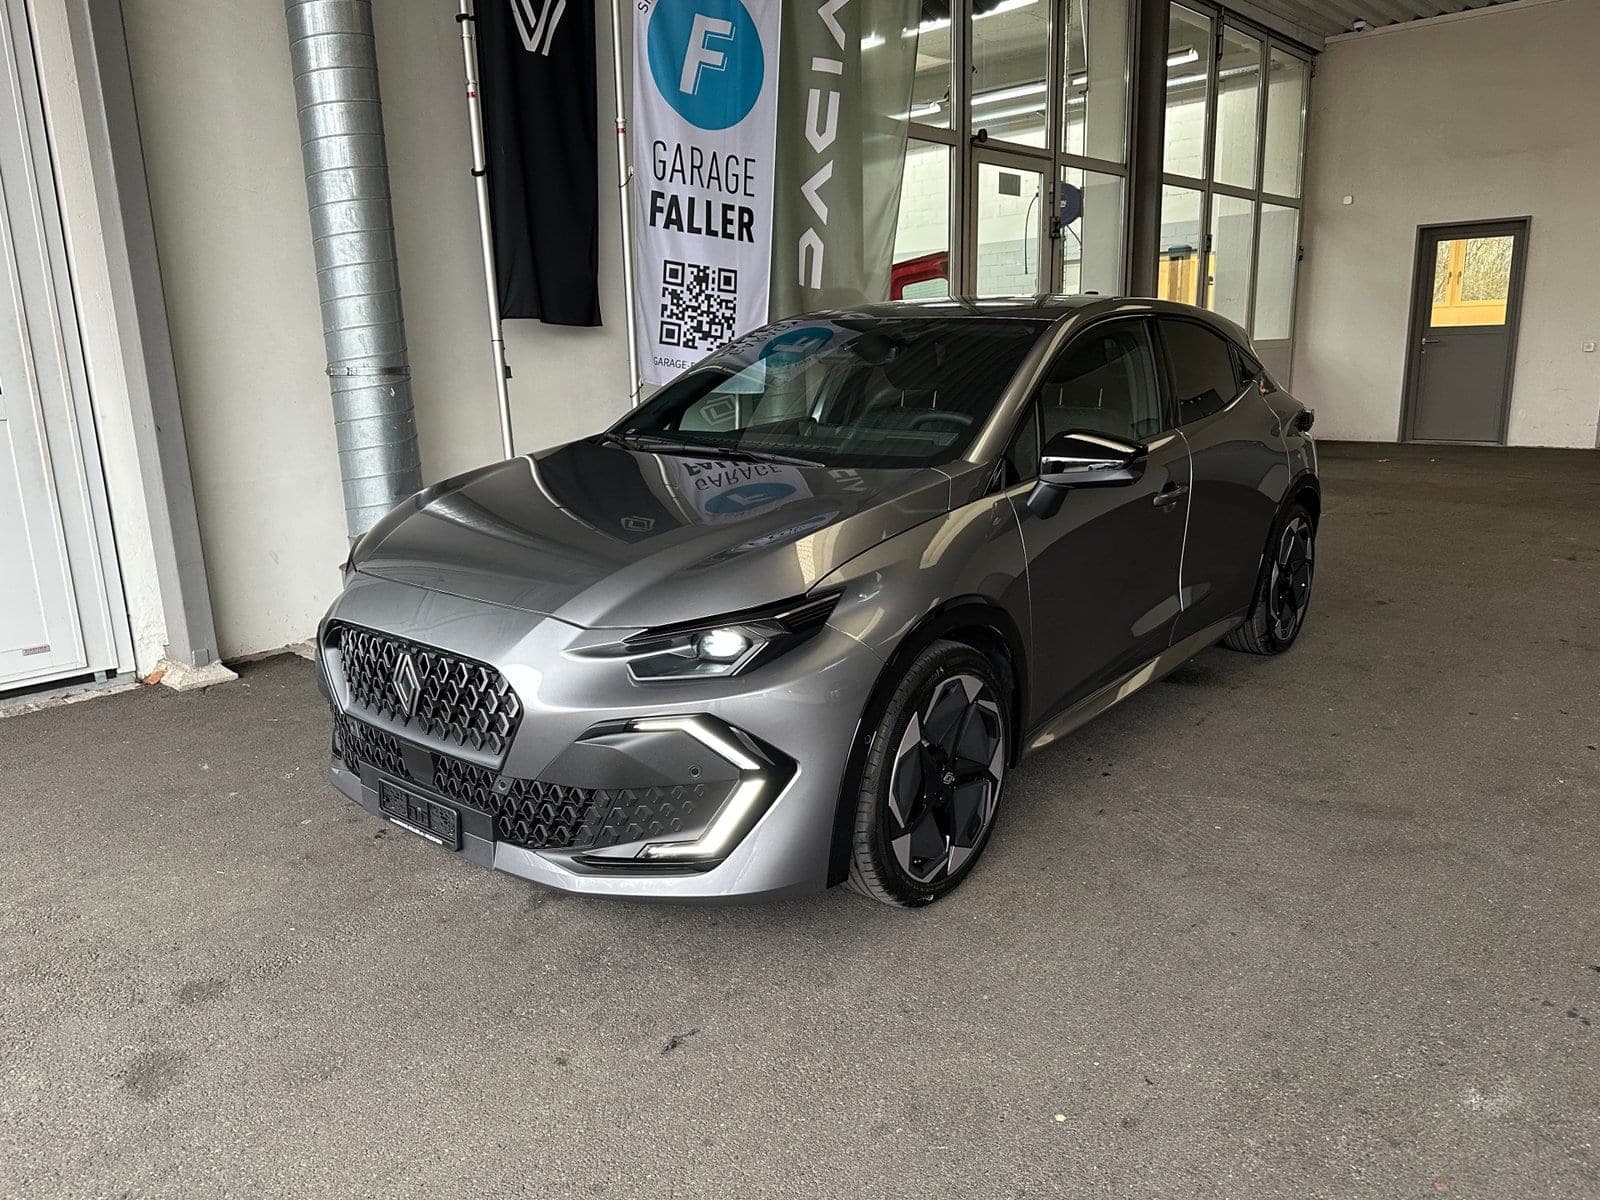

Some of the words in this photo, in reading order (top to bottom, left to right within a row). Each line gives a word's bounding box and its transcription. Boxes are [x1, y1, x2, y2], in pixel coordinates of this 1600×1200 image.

[680, 13, 736, 95] F
[652, 140, 756, 197] GARAGE
[649, 190, 754, 243] FALLER
